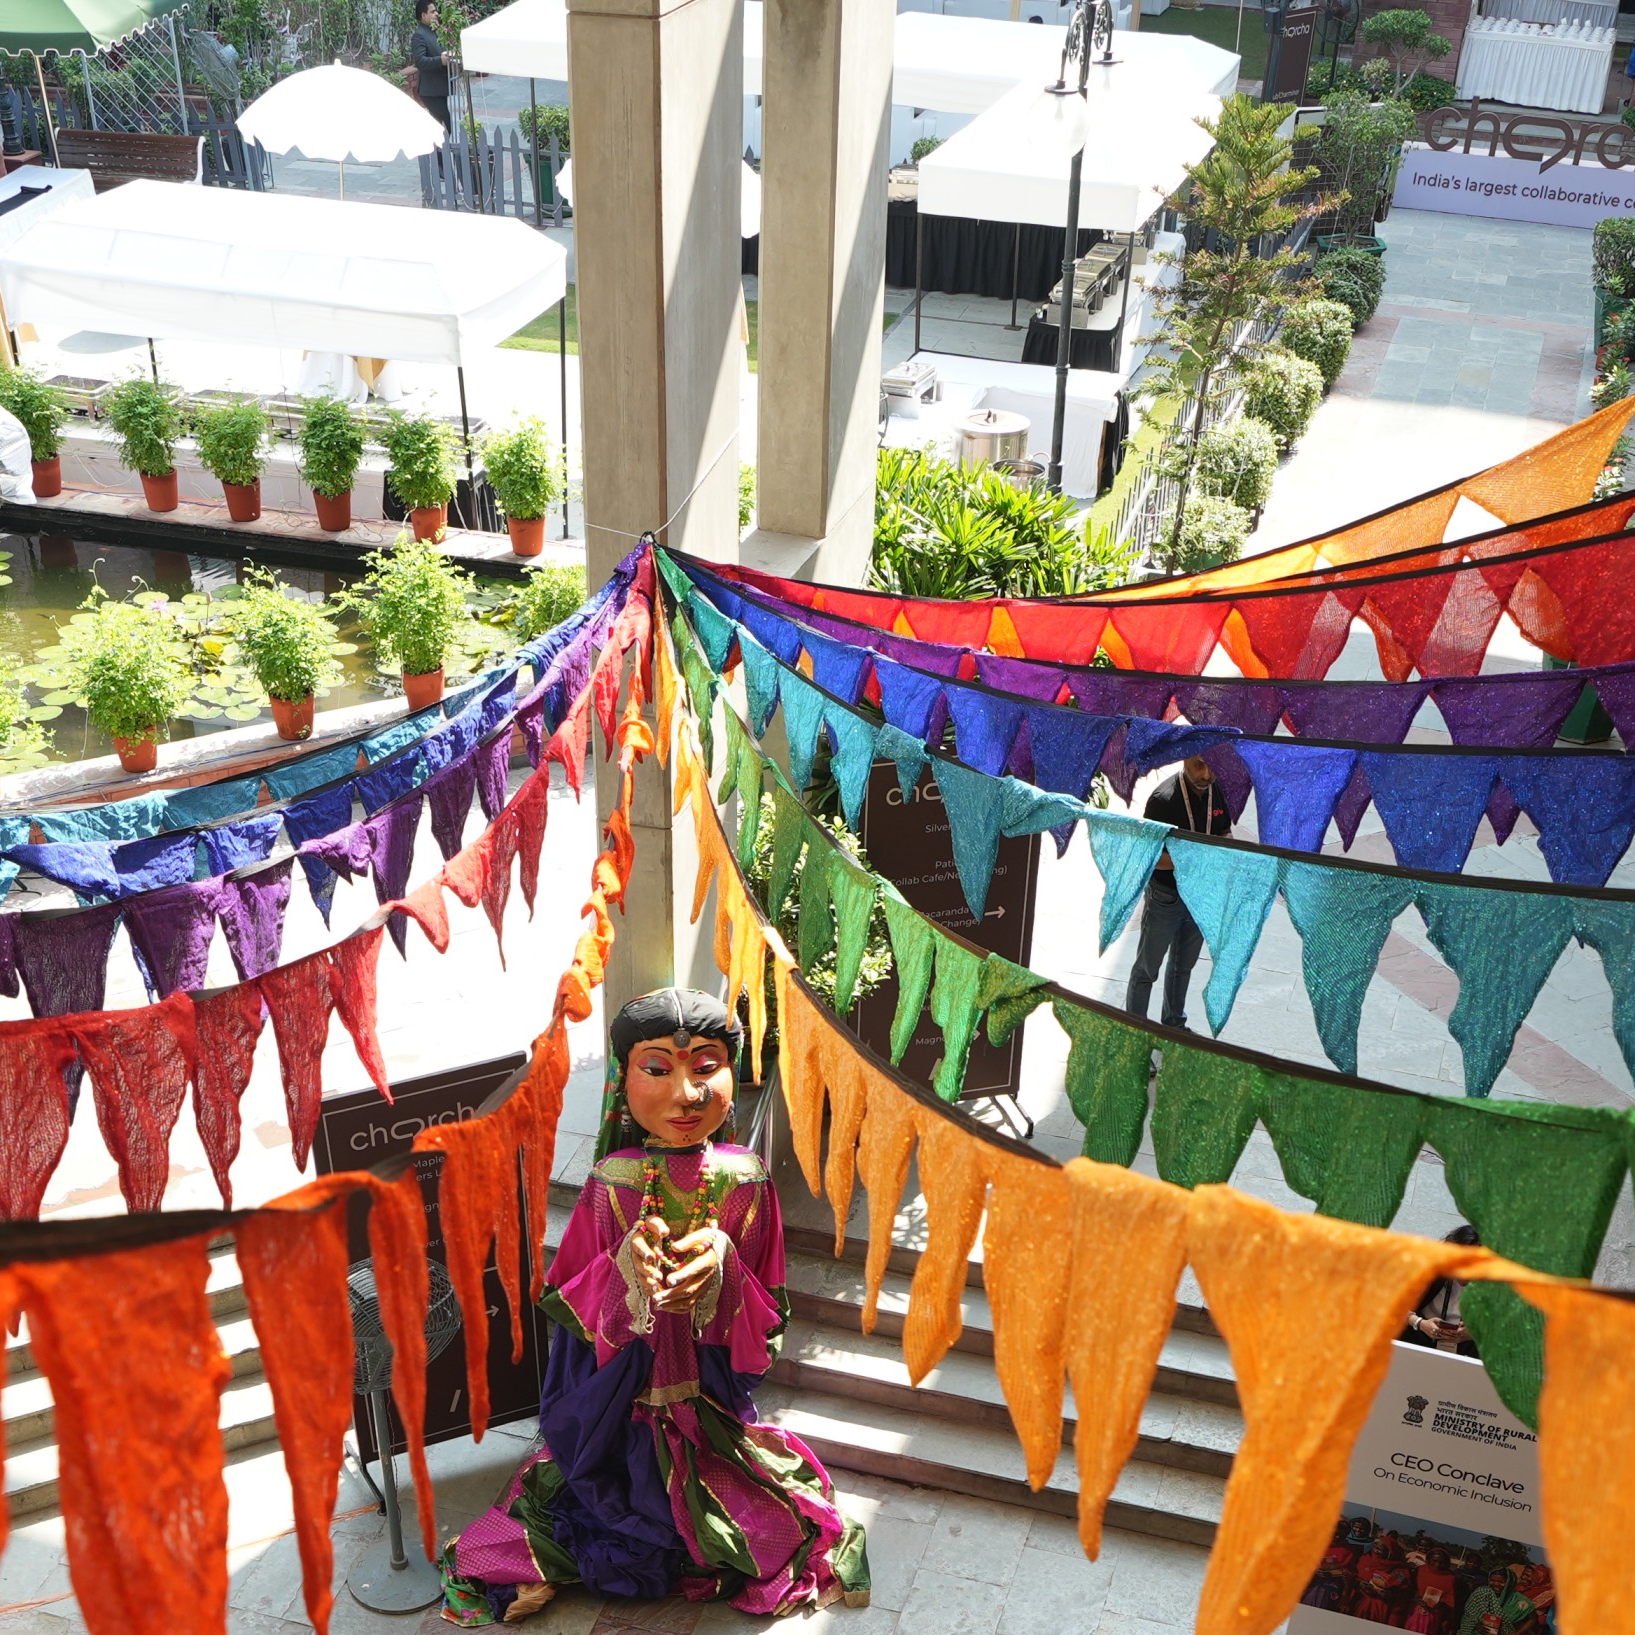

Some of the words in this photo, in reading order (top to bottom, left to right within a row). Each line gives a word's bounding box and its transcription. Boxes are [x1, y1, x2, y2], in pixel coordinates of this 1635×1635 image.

[1412, 171, 1461, 190] India's
[1465, 177, 1517, 196] largest
[1521, 185, 1620, 207] collaborative
[1431, 1426, 1482, 1442] GOVERNMENT
[1496, 1441, 1517, 1450] INDIA
[1433, 1420, 1508, 1442] DEVELOPMENT
[1434, 1413, 1485, 1430] MINISTRY
[1488, 1424, 1502, 1433] OF
[1503, 1428, 1537, 1442] RURAL
[1391, 1452, 1434, 1472] CEO
[1437, 1463, 1525, 1494] Conclave
[1373, 1467, 1395, 1481] On
[1397, 1472, 1469, 1498] Economic
[1470, 1490, 1532, 1512] Inclusion
